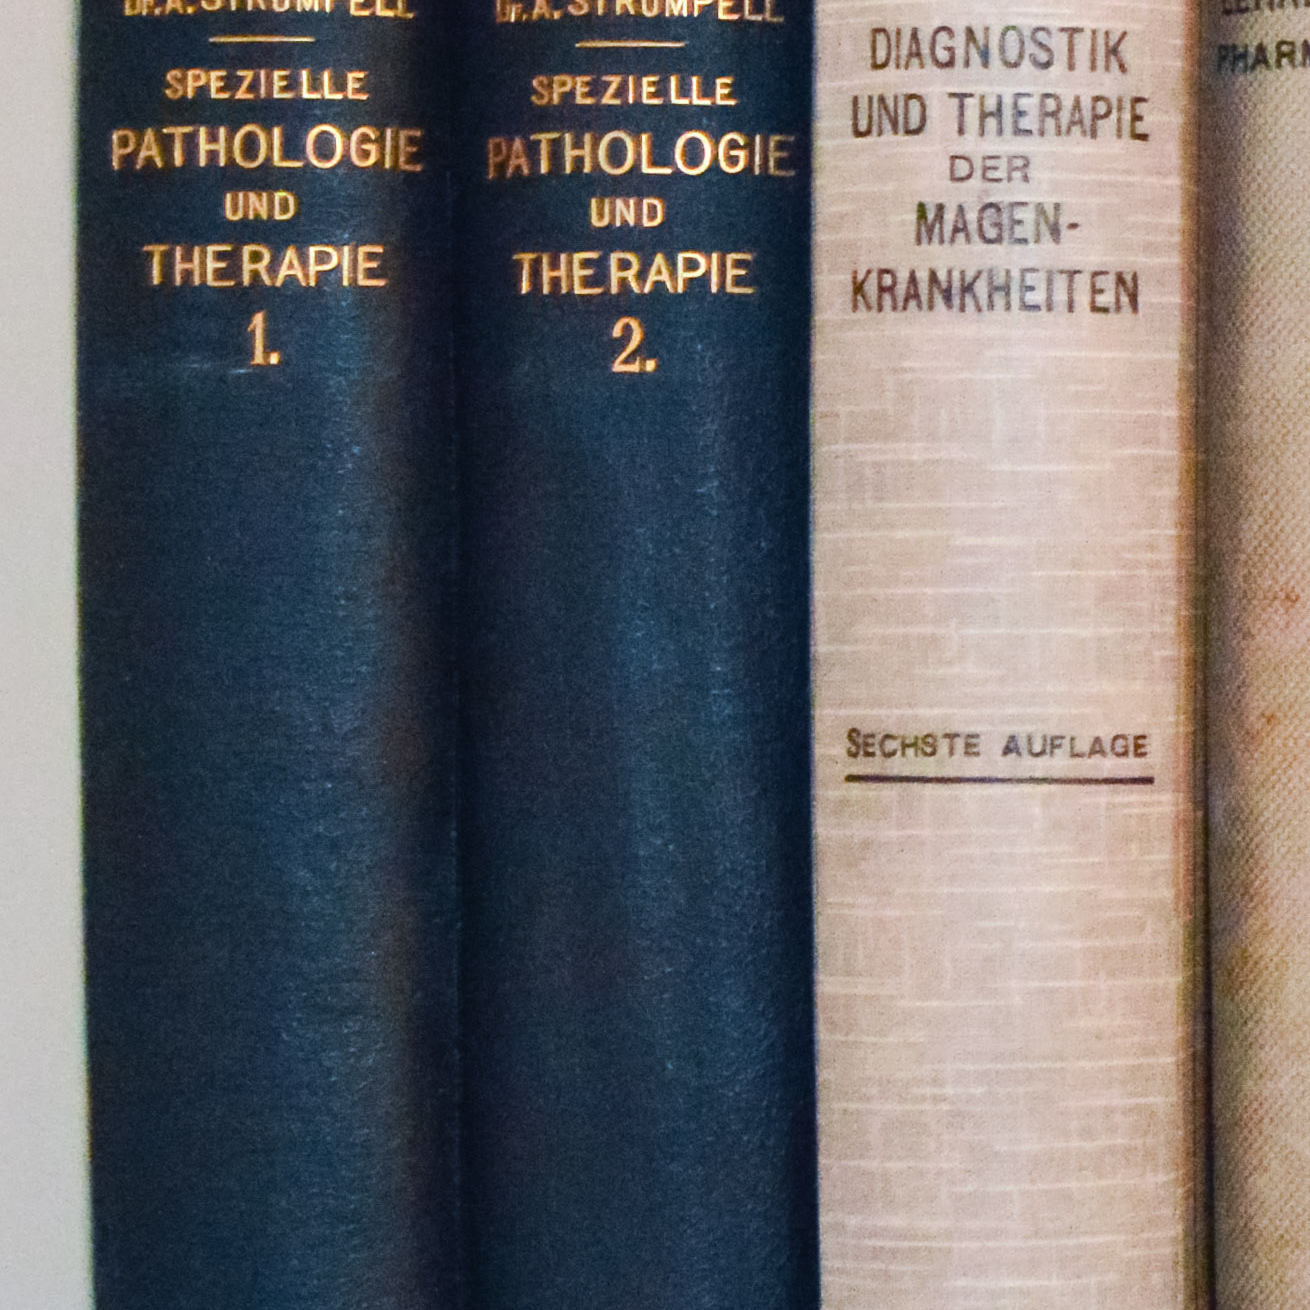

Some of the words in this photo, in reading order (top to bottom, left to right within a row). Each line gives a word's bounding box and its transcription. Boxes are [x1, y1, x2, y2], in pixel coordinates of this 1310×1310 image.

[870, 25, 1129, 74] DIAGNOSTIK
[165, 68, 369, 101] SPEZIELLE
[530, 75, 737, 106] SPEZIELLE
[851, 95, 927, 139] UND
[947, 92, 1150, 143] THERAPIE
[111, 123, 424, 172] PATHOLOGIE
[486, 130, 796, 178] PATHOLOGIE
[948, 153, 1030, 184] DER
[224, 191, 297, 221] UND
[590, 197, 665, 227] UND
[914, 201, 1080, 246] MAGEN-
[143, 243, 388, 287] THERAPIE
[513, 251, 757, 295] THERAPIE
[851, 268, 1140, 315] KRANKHEITEN
[248, 311, 280, 366] 1.
[611, 316, 658, 373] 2.
[846, 727, 981, 759] SECHSTE
[1001, 733, 1149, 759] AUFLAGE
